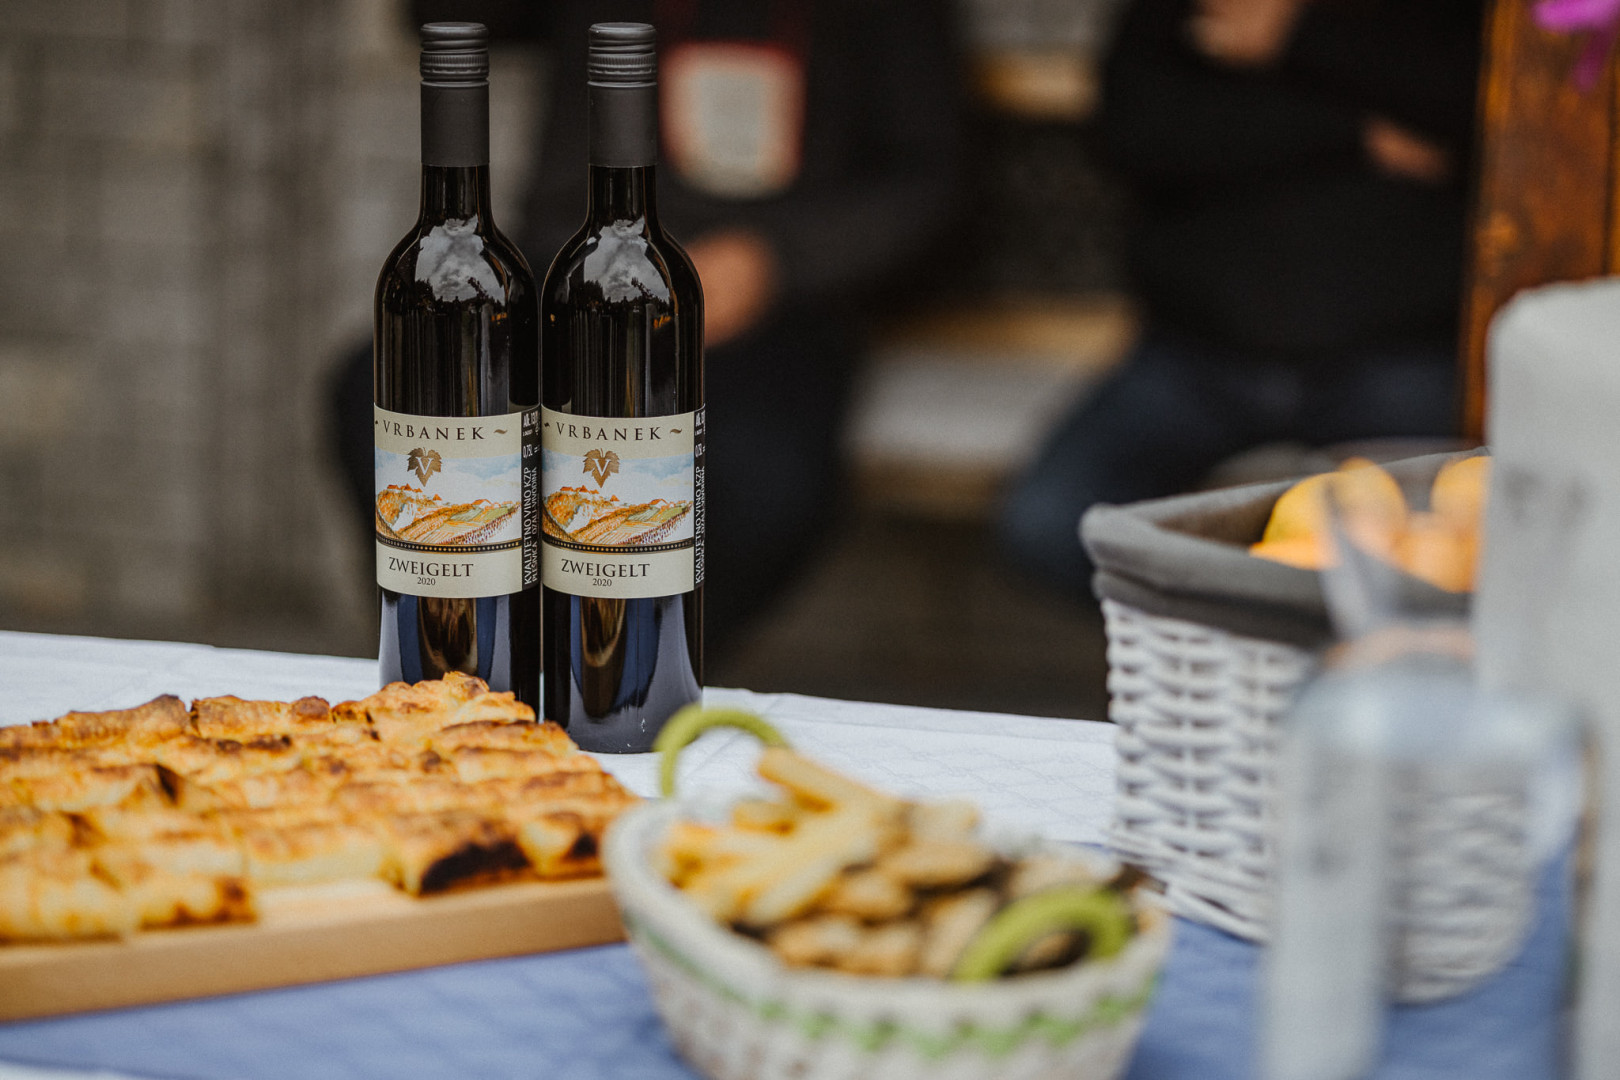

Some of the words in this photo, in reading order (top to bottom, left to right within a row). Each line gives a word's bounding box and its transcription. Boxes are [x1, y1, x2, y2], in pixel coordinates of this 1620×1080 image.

[383, 420, 485, 440] VRBANEK
[556, 422, 661, 441] VRBANEK
[416, 457, 433, 475] V
[592, 458, 612, 476] V
[524, 467, 532, 488] KZP
[523, 490, 532, 518] VINO
[523, 519, 532, 585] KVALITETNO
[389, 557, 474, 577] ZWEIGELT
[561, 559, 650, 577] ZWEIGELT
[417, 577, 436, 586] 2020
[592, 578, 612, 587] 2020
